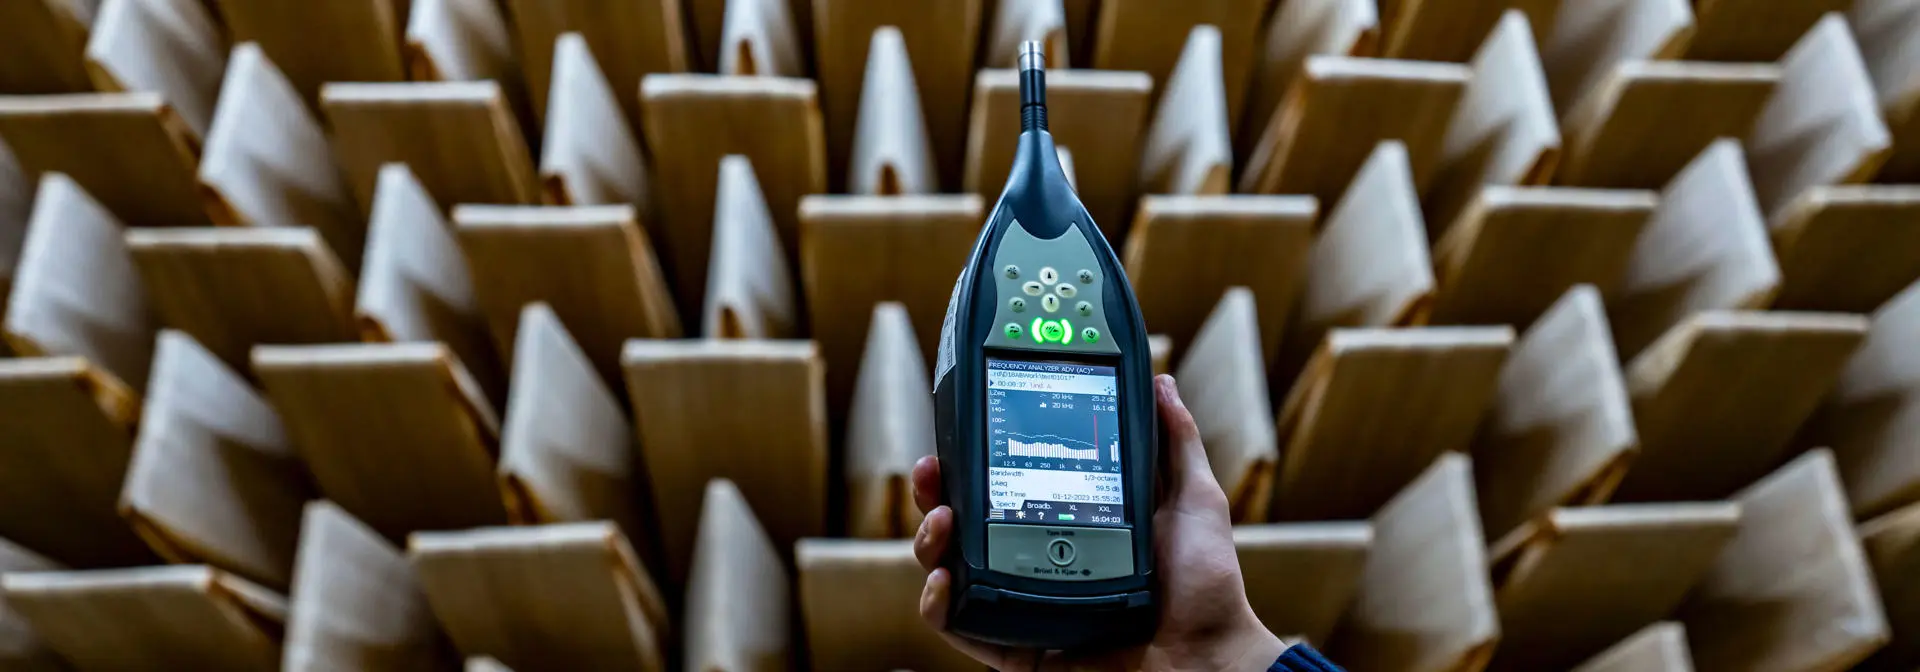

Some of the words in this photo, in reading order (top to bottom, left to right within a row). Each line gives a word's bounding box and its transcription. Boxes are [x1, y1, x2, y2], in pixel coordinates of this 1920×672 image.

[988, 361, 1027, 370] FREQUENCY
[1027, 364, 1060, 372] ANALYZER
[990, 470, 1025, 478] Bandwidth
[1098, 505, 1111, 513] XXL
